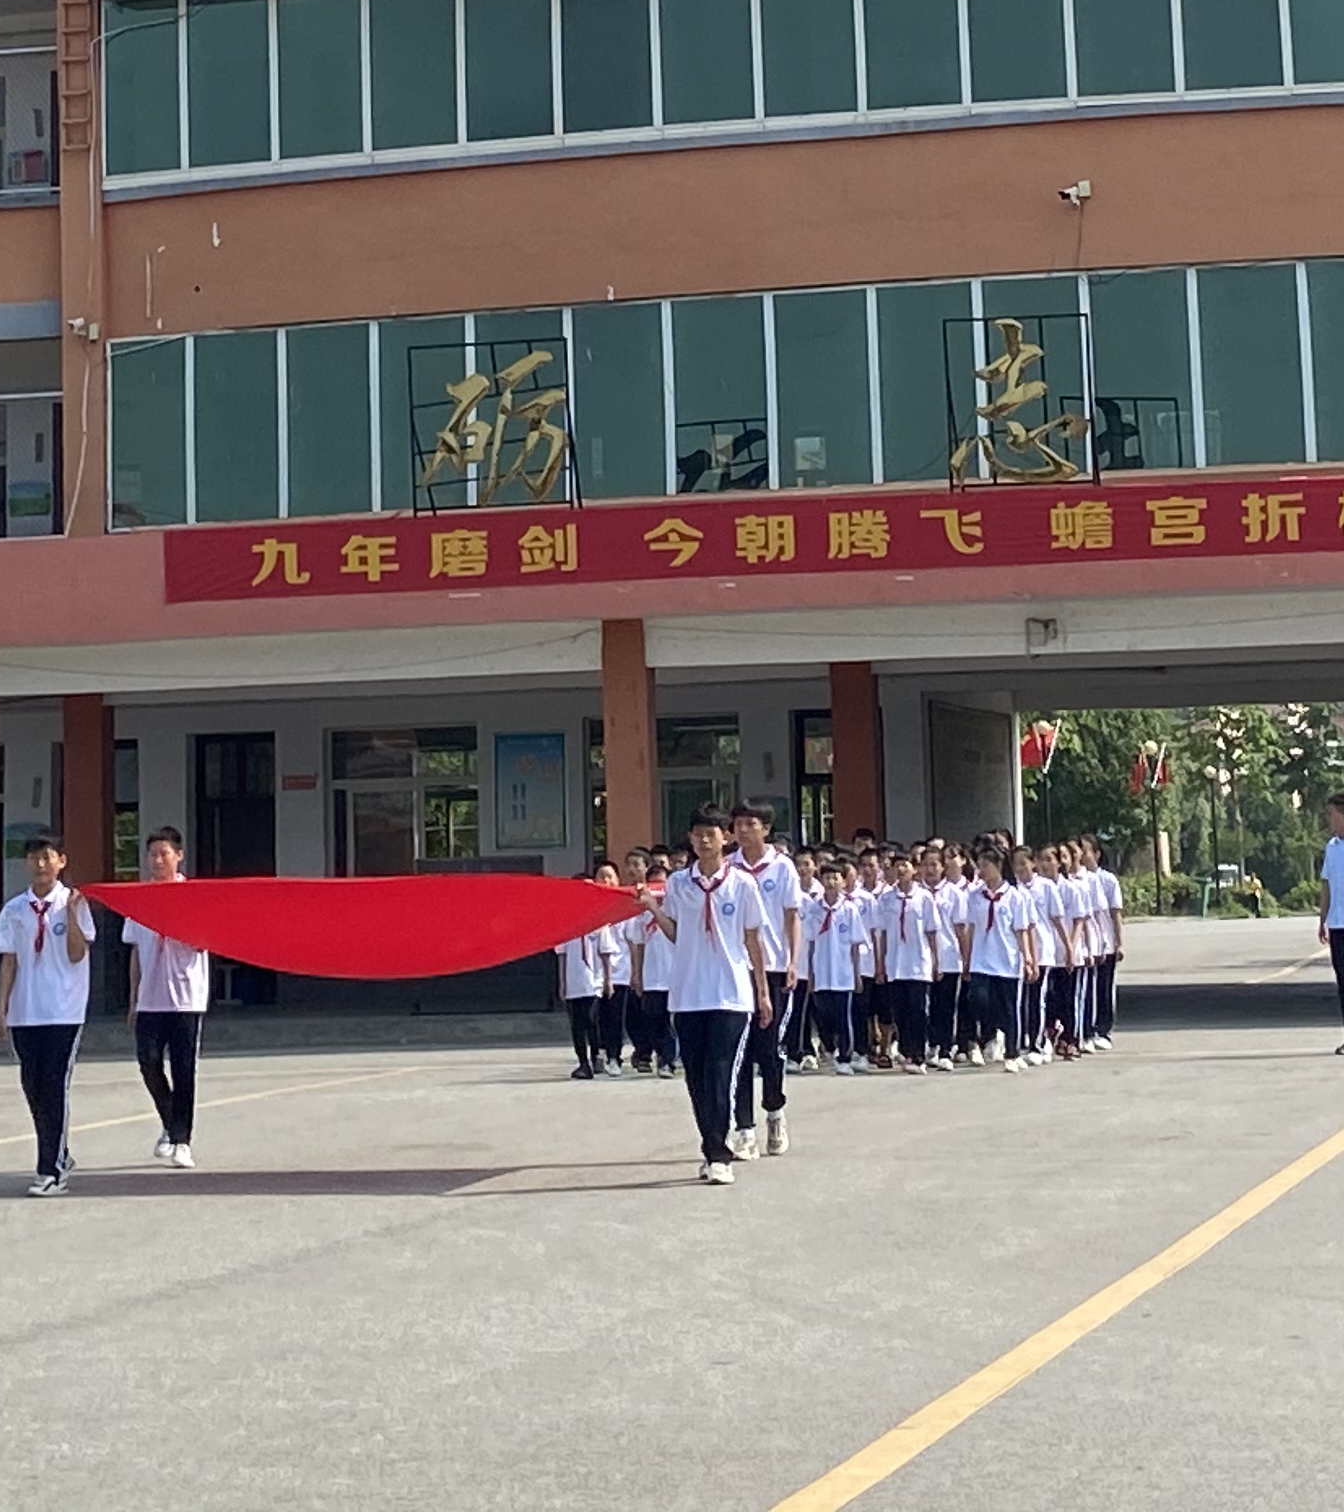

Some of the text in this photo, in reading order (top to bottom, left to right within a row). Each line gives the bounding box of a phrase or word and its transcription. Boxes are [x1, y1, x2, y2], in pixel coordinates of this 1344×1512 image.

[251, 522, 579, 586] 九年磨剑
[643, 507, 986, 567] 今朝腾飞
